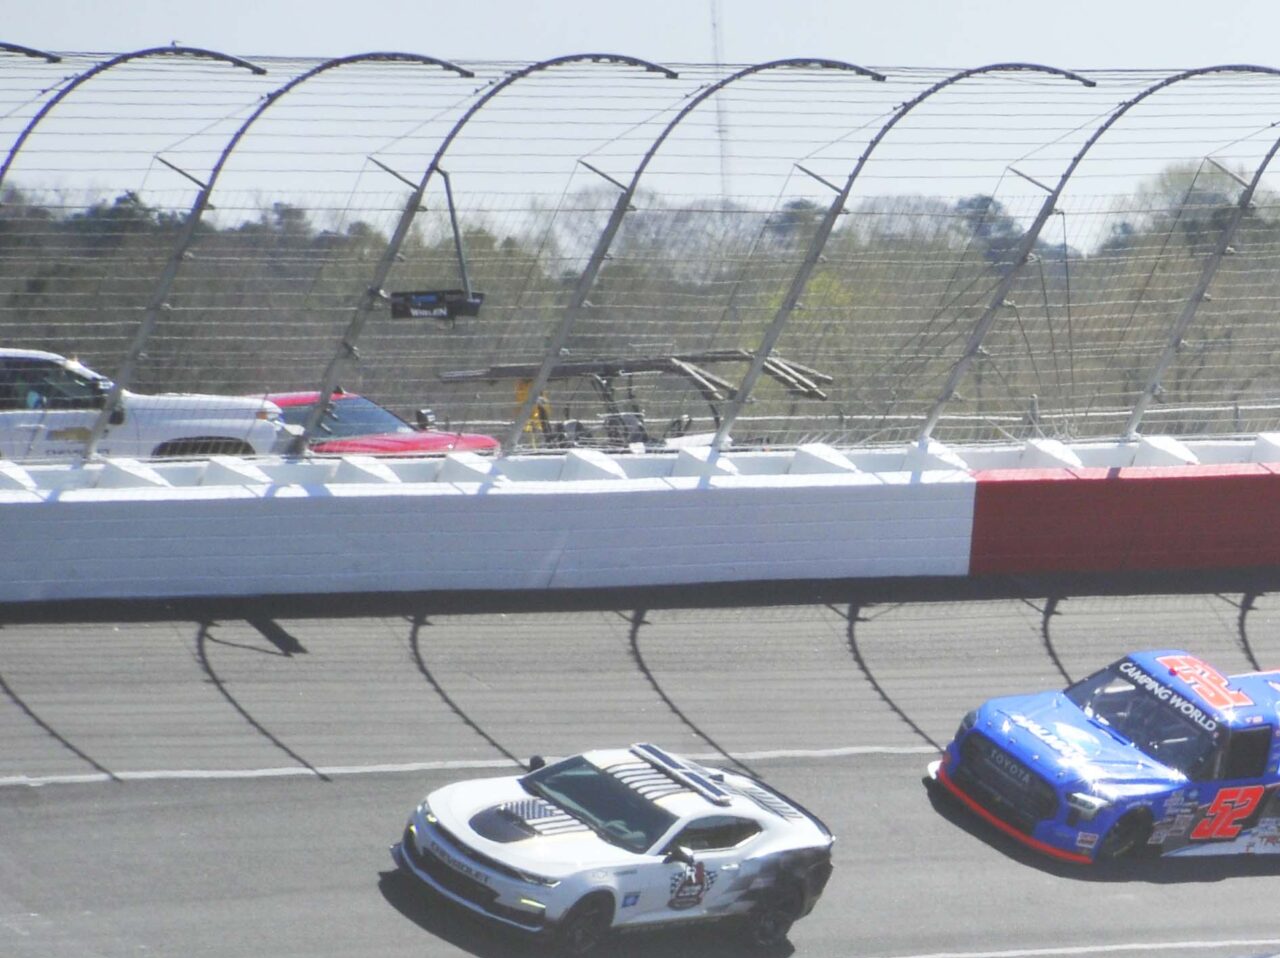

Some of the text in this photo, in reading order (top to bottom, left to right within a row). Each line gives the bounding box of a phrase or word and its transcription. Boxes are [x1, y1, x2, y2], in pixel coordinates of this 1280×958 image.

[1119, 662, 1217, 732] CAMPING WORLD
[990, 749, 1030, 783] TOYOTA
[1190, 785, 1265, 840] 52
